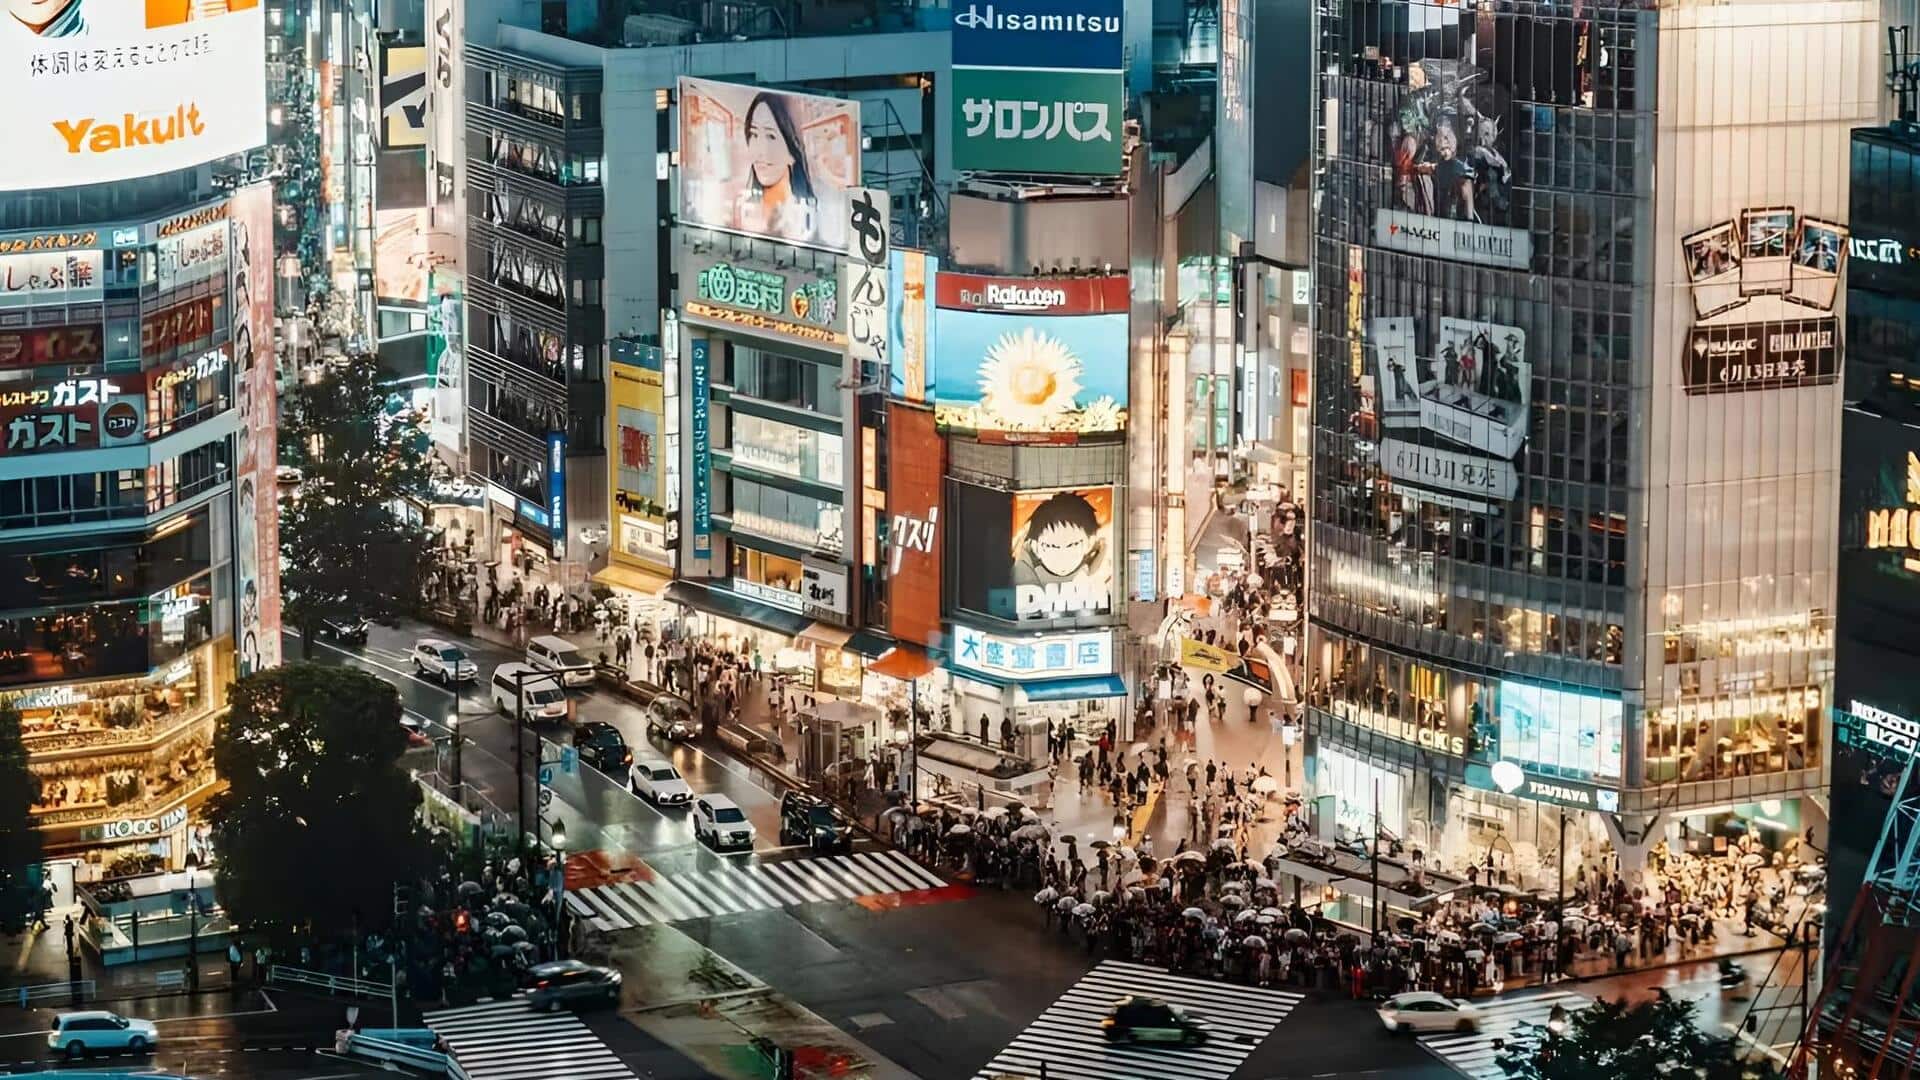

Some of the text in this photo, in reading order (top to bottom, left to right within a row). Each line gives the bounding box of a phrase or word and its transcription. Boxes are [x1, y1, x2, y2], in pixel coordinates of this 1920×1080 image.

[955, 4, 1120, 33] Hisamitsu
[52, 102, 206, 153] Yakult
[962, 98, 1112, 142] サロンパス
[850, 190, 886, 359] もんじゃ
[987, 284, 1066, 305] Rakuten
[196, 348, 228, 379] ガスト
[52, 378, 121, 407] ガスト
[8, 414, 92, 449] ガスト
[890, 504, 940, 576] クスリ
[1529, 781, 1590, 803] TSUTAYA
